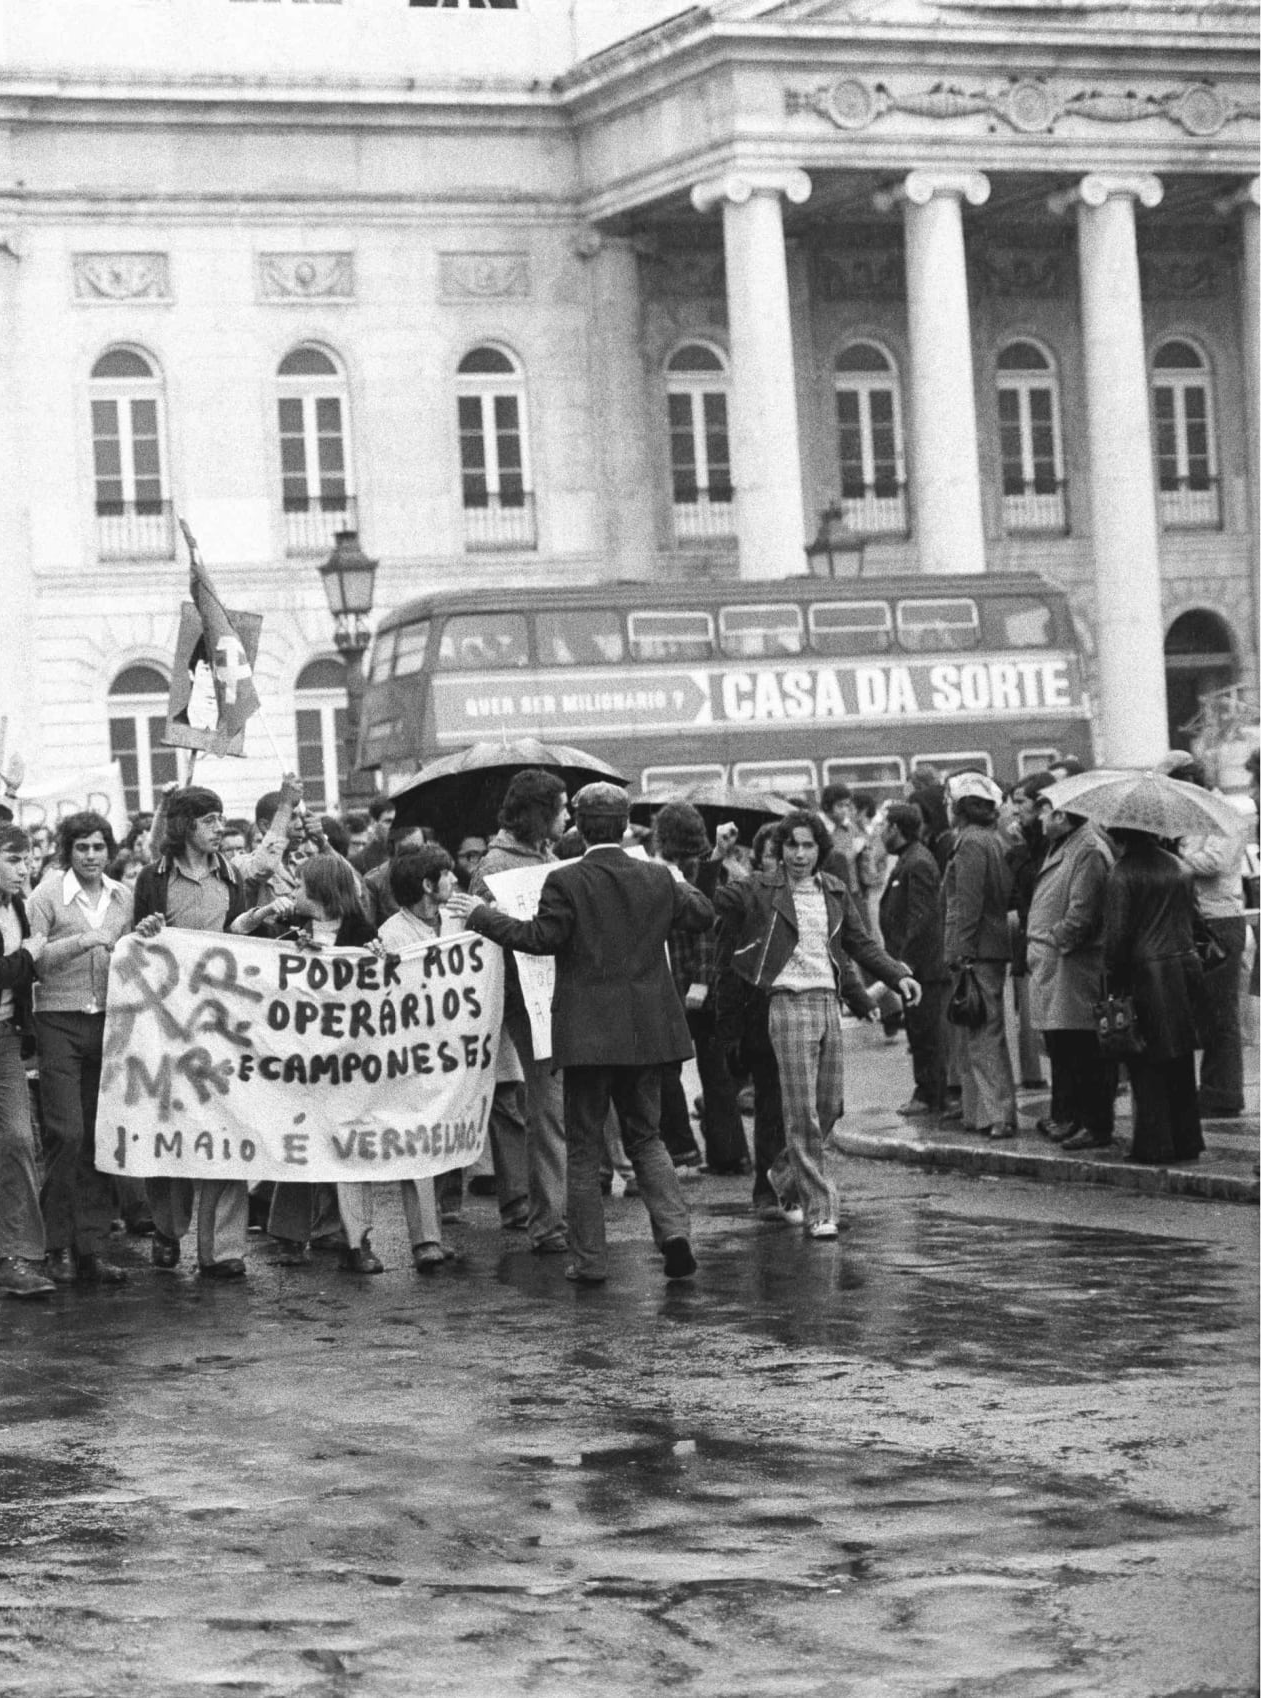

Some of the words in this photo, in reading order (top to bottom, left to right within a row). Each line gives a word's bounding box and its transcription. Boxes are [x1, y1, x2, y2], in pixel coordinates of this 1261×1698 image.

[520, 695, 556, 713] SER
[722, 667, 846, 720] CASA
[856, 665, 919, 716] DA
[931, 661, 1071, 712] SORTE
[278, 952, 401, 991] PODER
[423, 939, 484, 978] AOS
[267, 983, 482, 1039] OPERÁRIOS
[154, 1127, 256, 1162] MAIO
[283, 1112, 310, 1166] É
[331, 1095, 488, 1161] VERMELHO!
